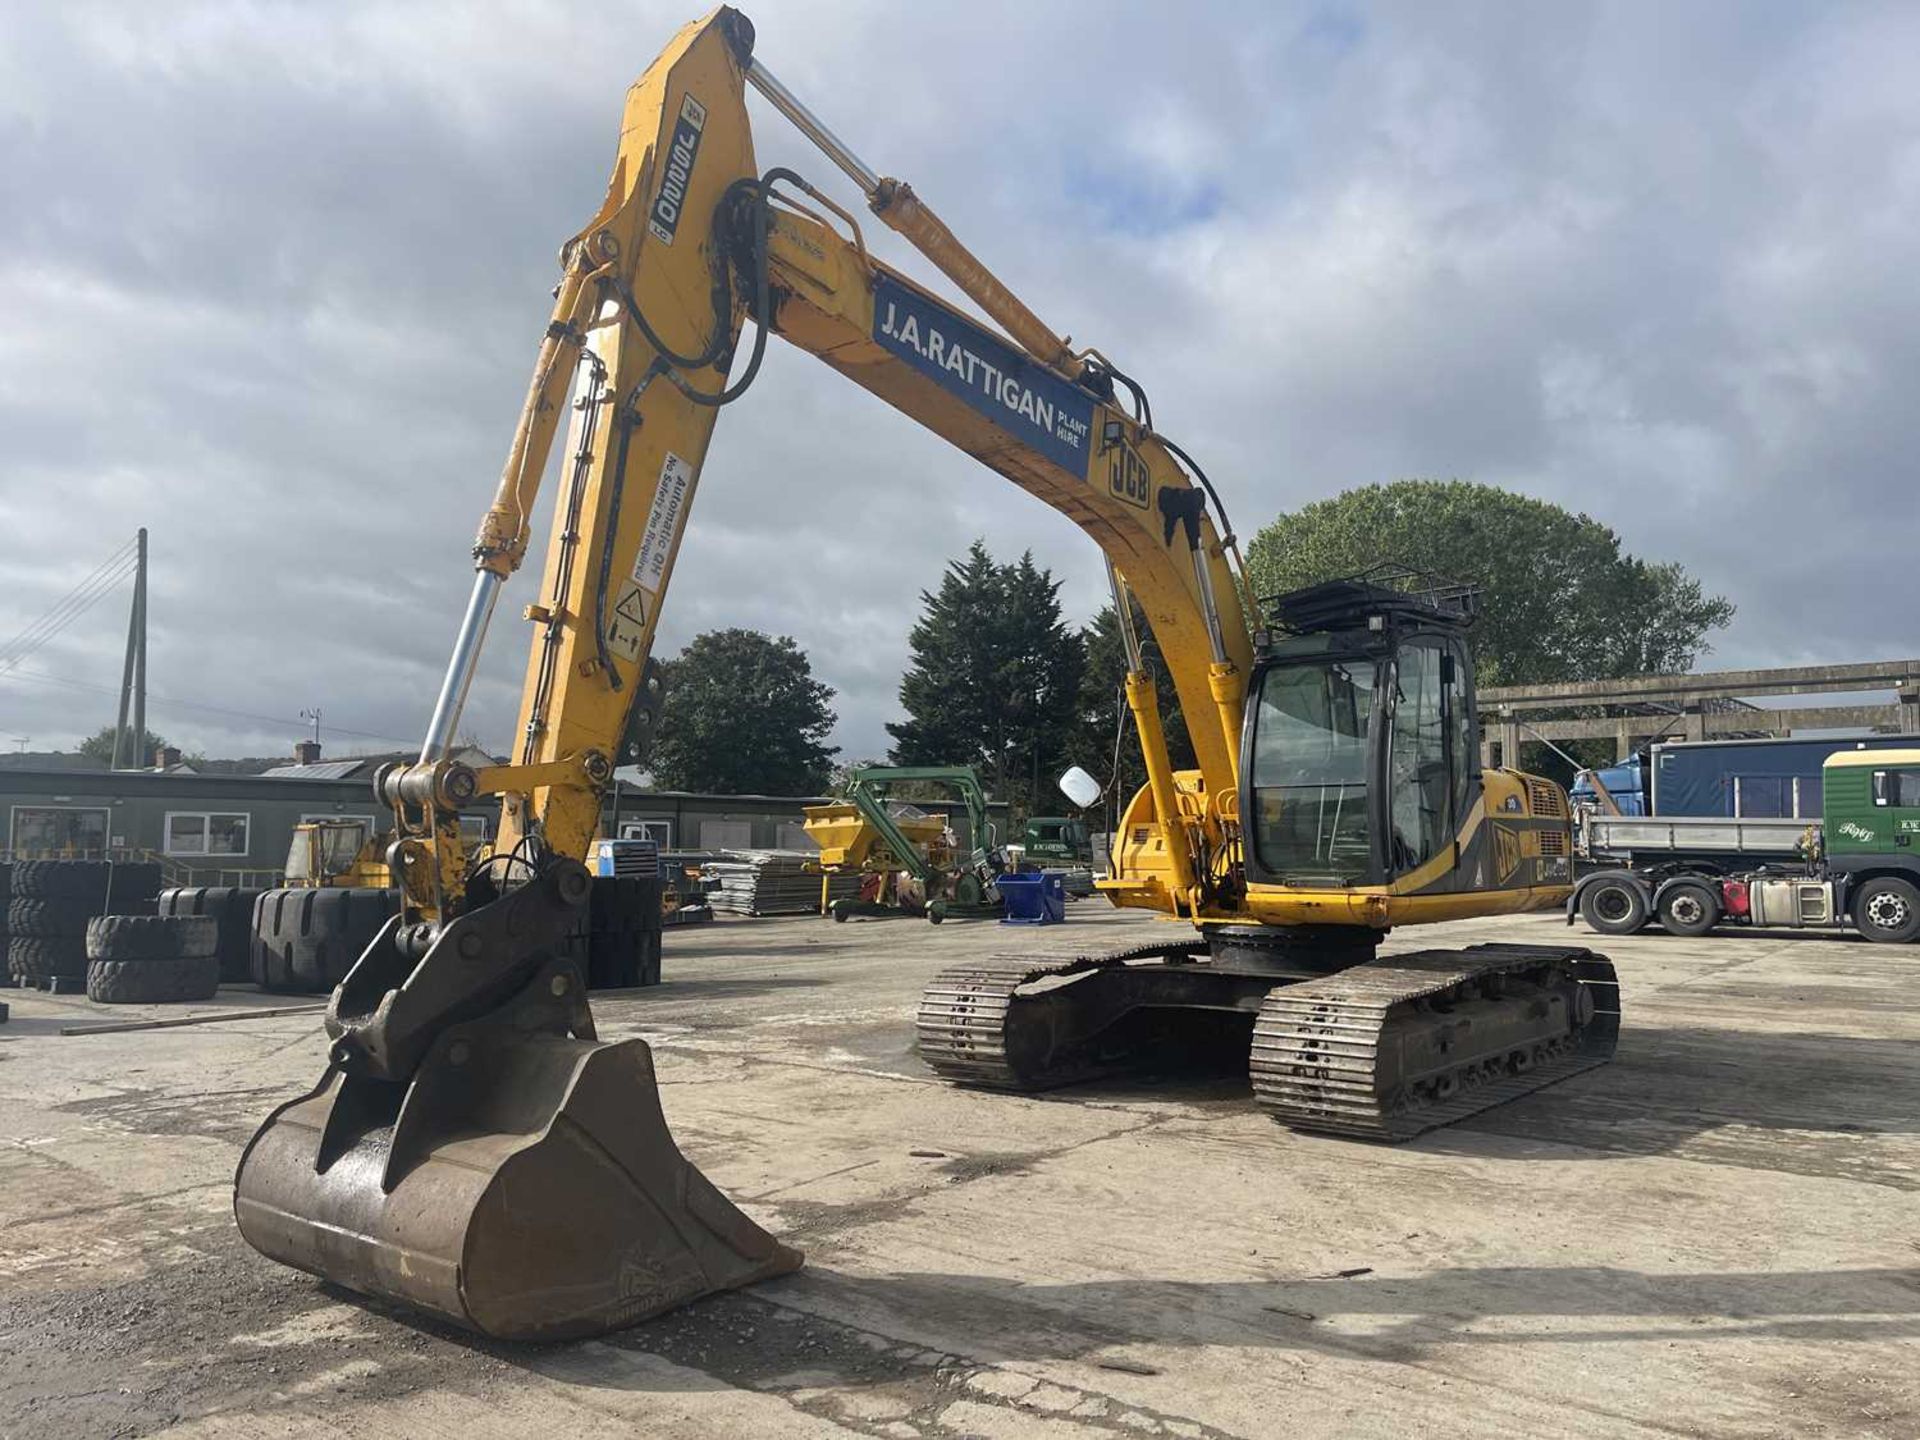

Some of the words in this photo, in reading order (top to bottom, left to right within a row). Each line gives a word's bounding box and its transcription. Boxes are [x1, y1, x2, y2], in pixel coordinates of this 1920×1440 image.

[882, 302, 1053, 433] J.A.RATTIGAN
[1057, 425, 1079, 448] HIRE
[1058, 410, 1088, 438] PLANT
[666, 455, 677, 472] No
[1113, 442, 1148, 502] JCB
[654, 472, 673, 509] Safety
[649, 510, 662, 529] Pin
[657, 474, 687, 550] Automatic
[634, 529, 656, 581] Required
[650, 552, 666, 577] QH
